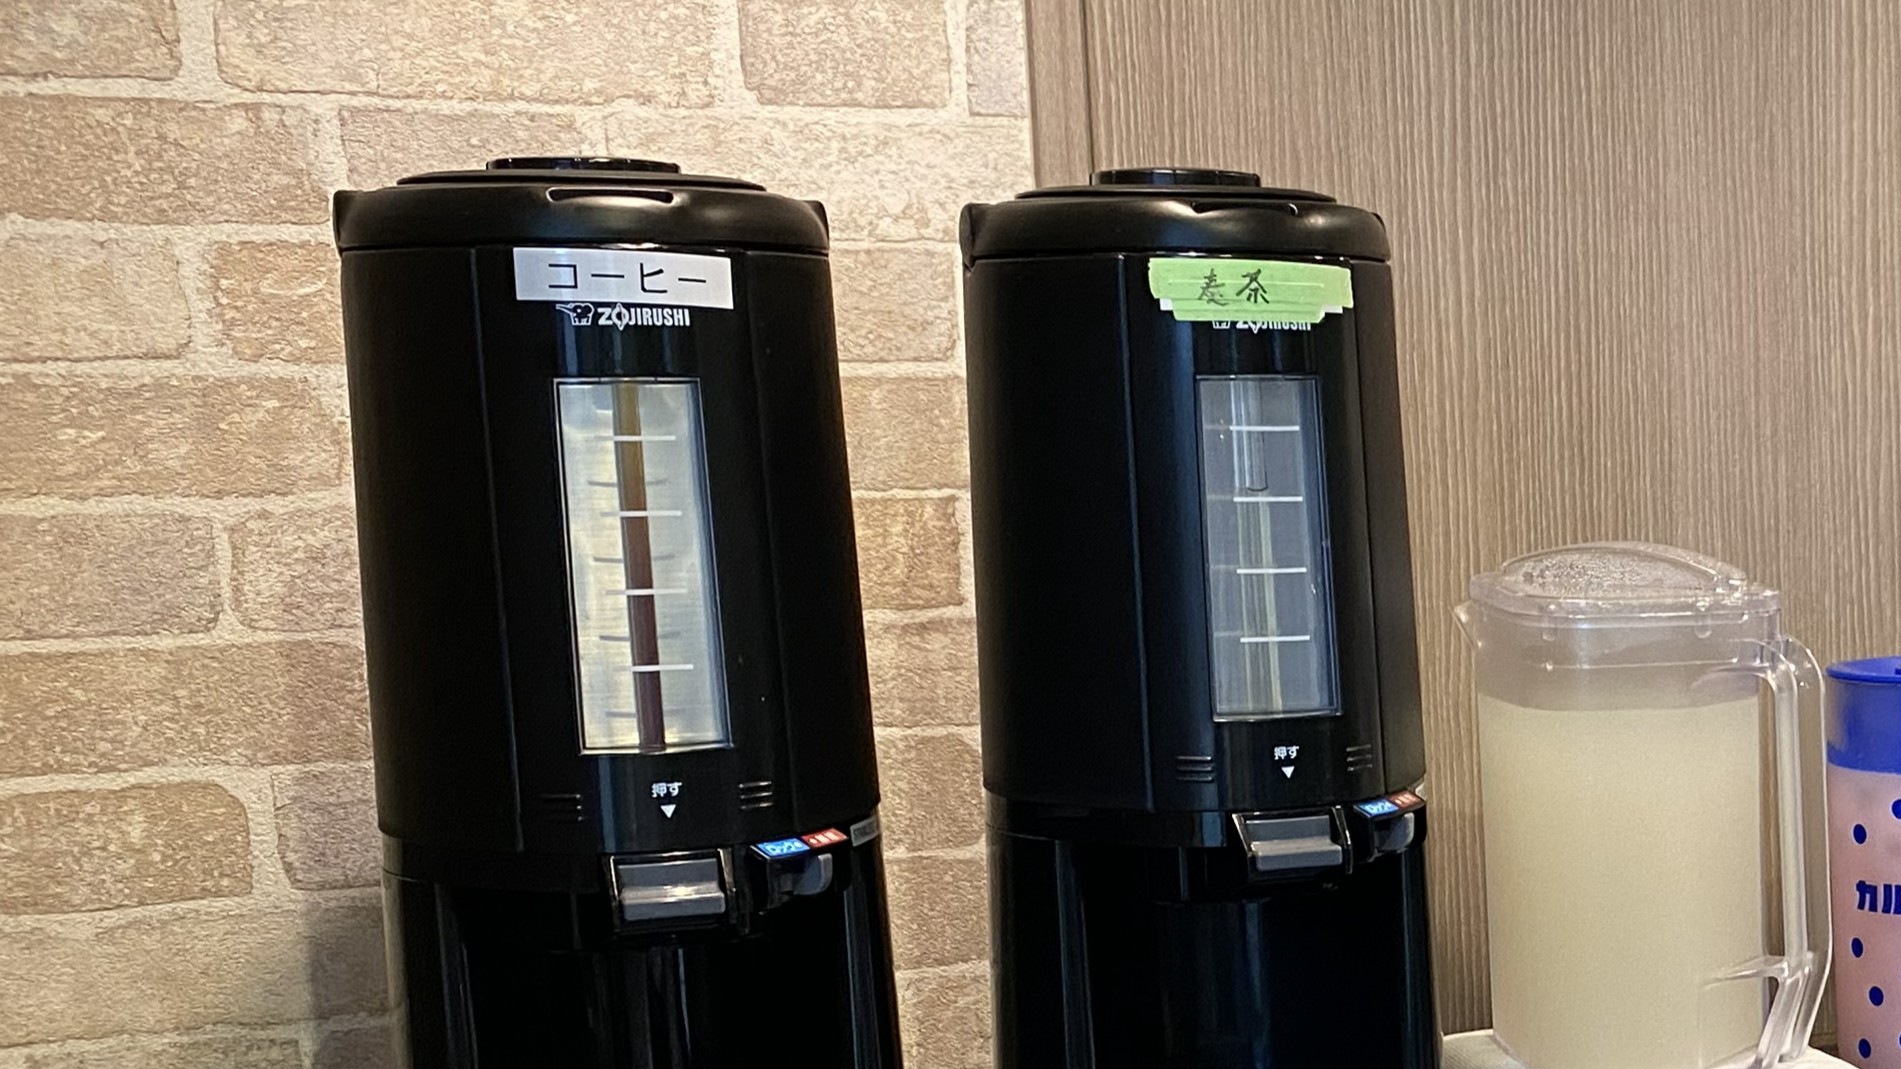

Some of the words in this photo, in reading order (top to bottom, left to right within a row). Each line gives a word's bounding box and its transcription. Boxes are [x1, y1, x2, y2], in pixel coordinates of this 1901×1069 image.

[548, 262, 706, 294] コーヒー
[597, 303, 690, 330] ZOJIRUSHI
[1273, 745, 1299, 760] 押す
[651, 781, 682, 797] 押す
